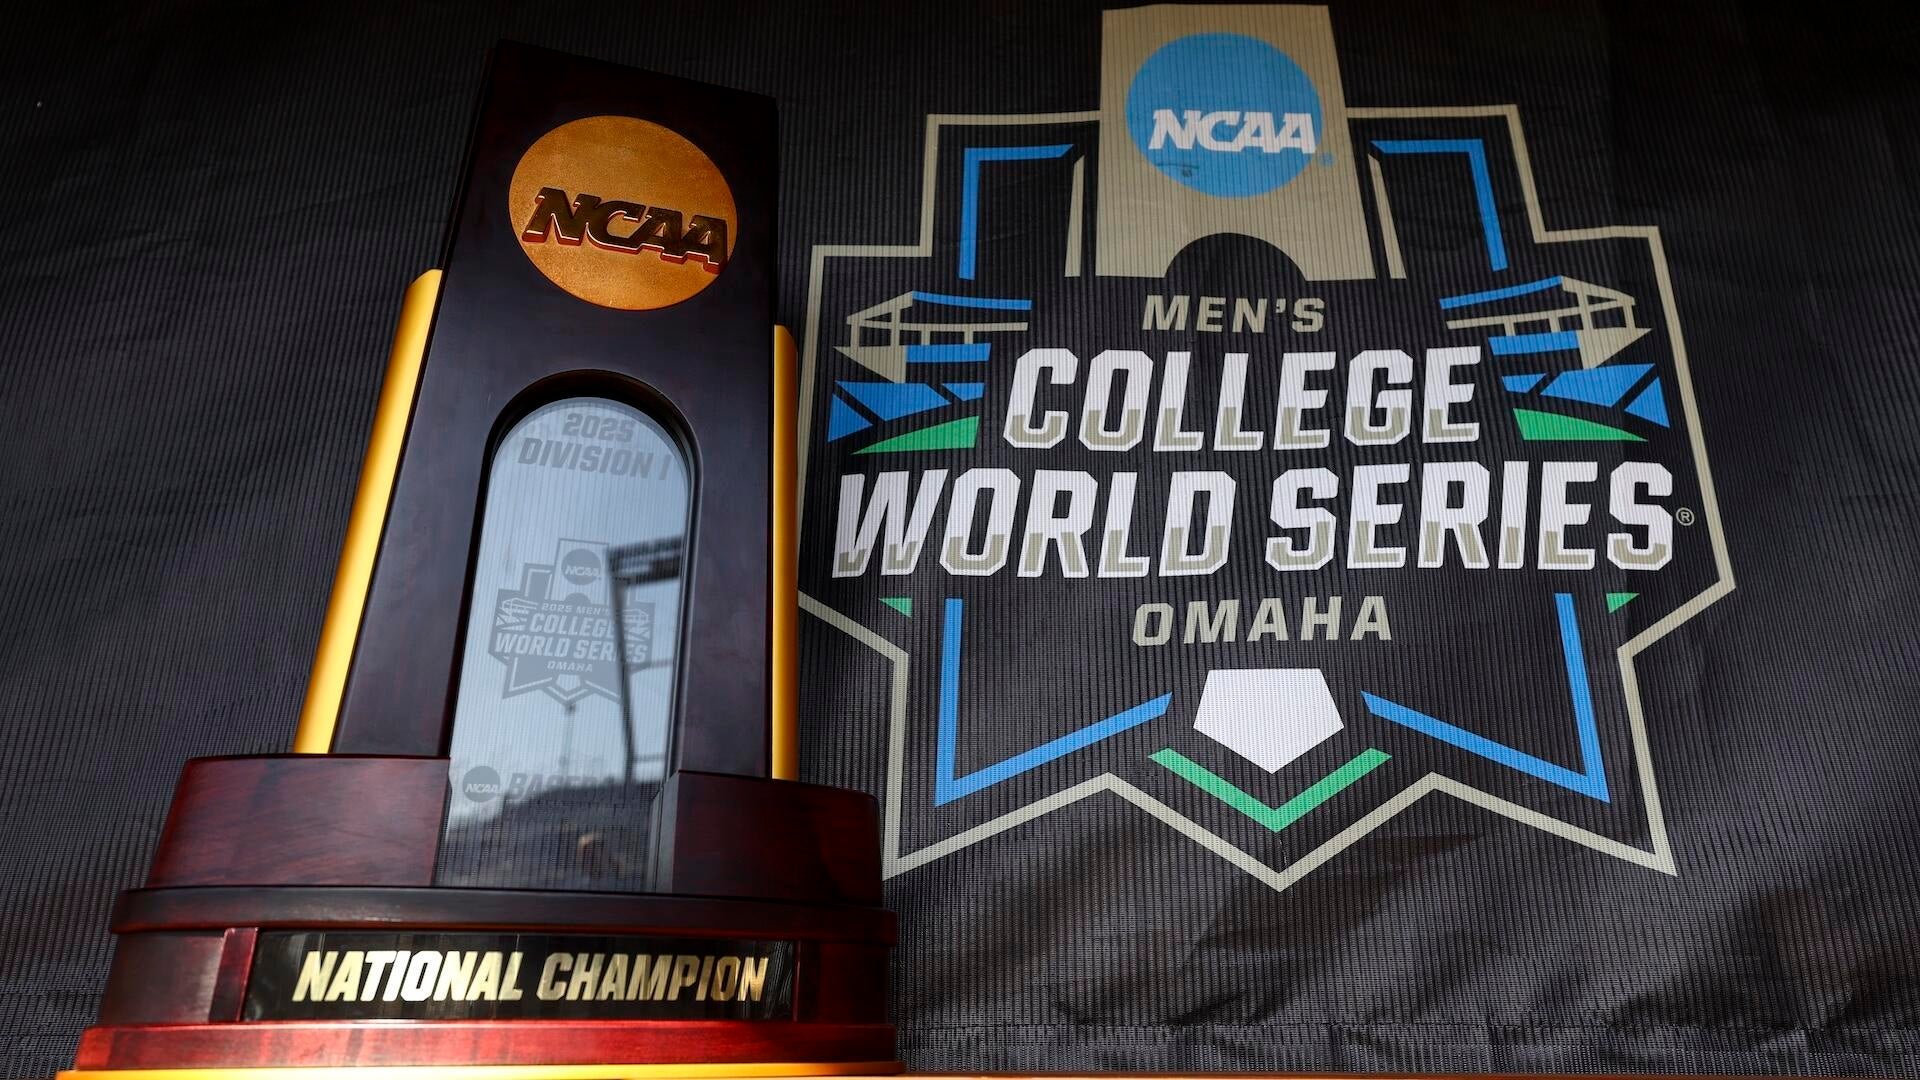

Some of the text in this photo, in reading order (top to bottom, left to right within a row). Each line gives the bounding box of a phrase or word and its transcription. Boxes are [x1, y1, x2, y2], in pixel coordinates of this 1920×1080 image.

[1148, 108, 1316, 154] NCAA
[521, 186, 729, 275] NCAA
[1003, 346, 1482, 454] COLLEGE
[561, 413, 635, 442] 2025
[517, 437, 672, 480] DIVISION I
[831, 466, 1236, 580] WORLD
[1132, 594, 1393, 647] OMAHA
[494, 633, 648, 664] WORLD SERES
[547, 660, 593, 673] OMAHA
[465, 783, 500, 793] NCAA
[293, 950, 769, 1001] NATIONAL CHAMPION
